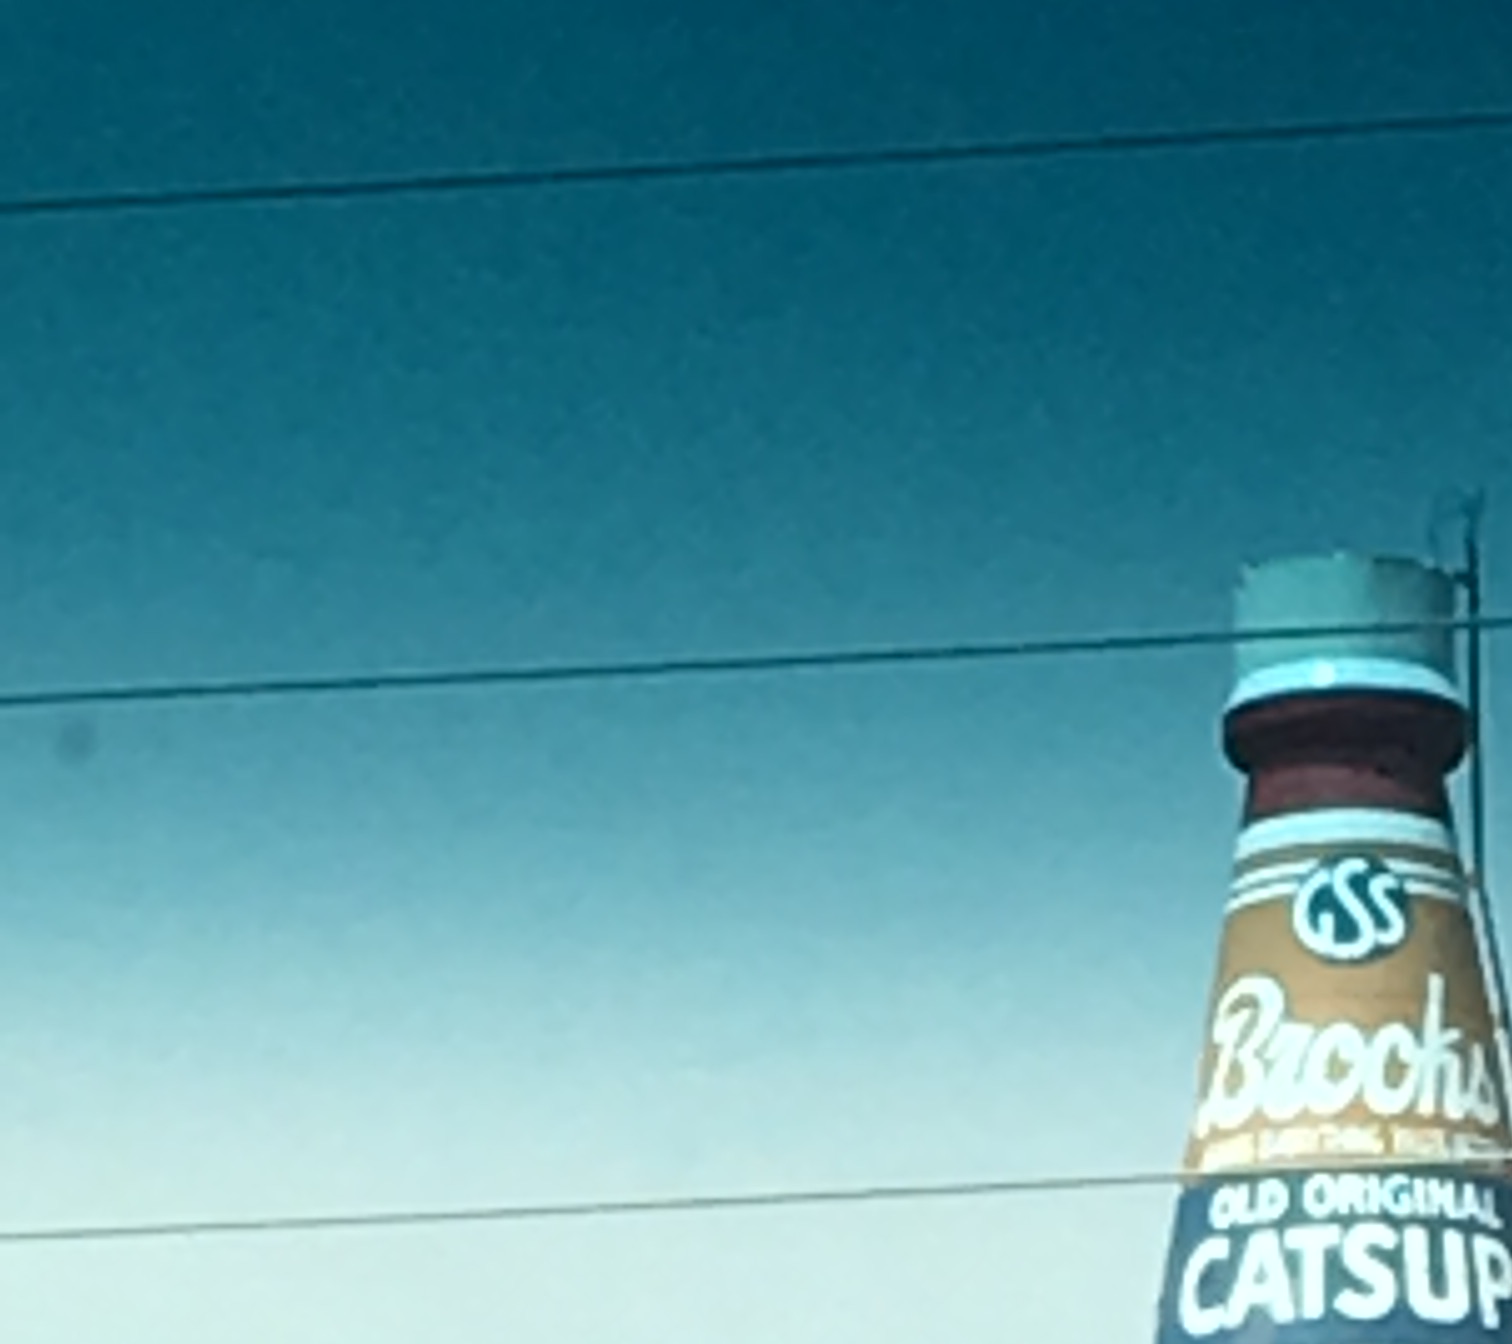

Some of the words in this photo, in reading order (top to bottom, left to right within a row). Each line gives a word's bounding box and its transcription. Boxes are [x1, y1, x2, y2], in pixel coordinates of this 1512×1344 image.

[1194, 972, 1500, 1139] Brooks
[1208, 1177, 1290, 1230] OLD
[1302, 1172, 1504, 1229] ORIGINAL
